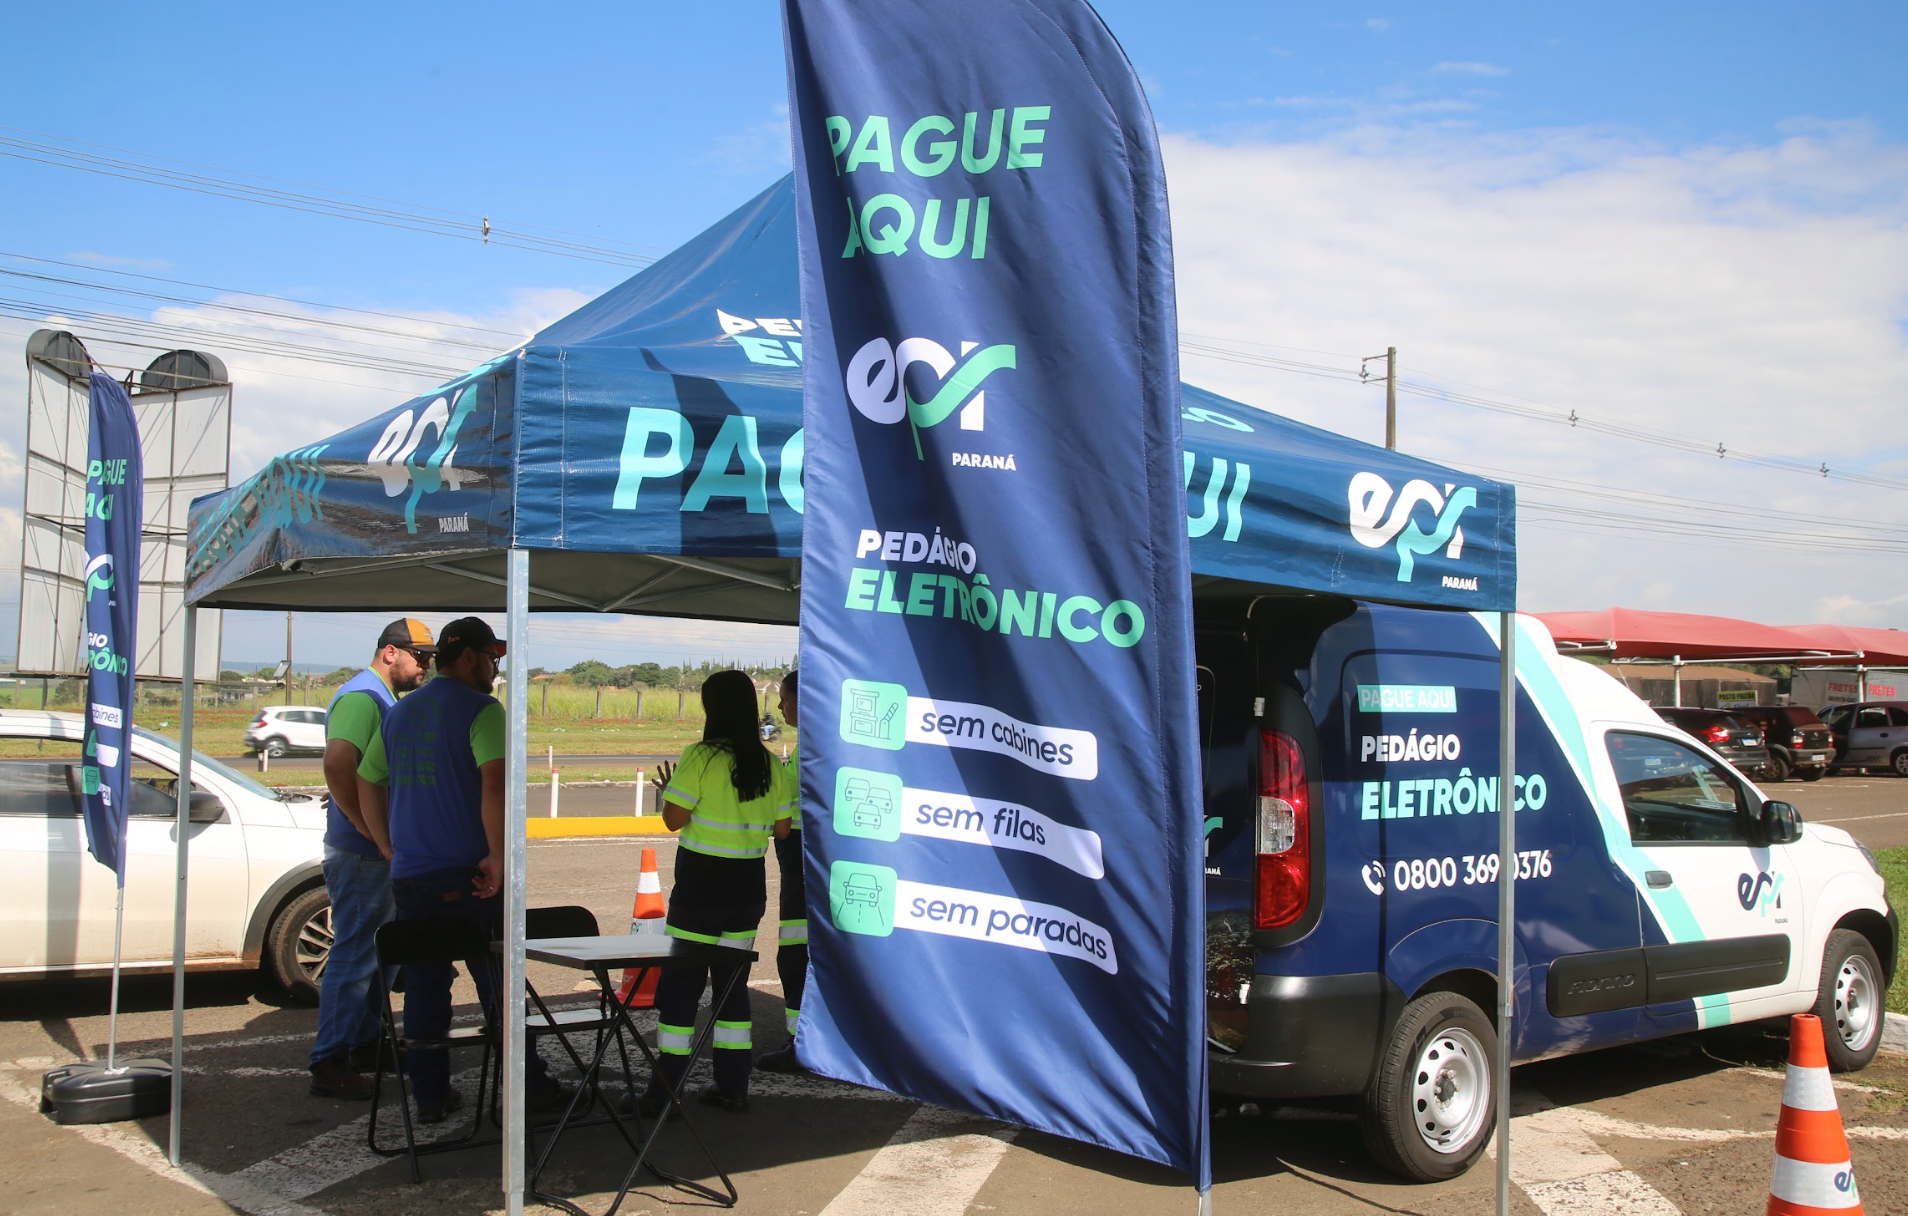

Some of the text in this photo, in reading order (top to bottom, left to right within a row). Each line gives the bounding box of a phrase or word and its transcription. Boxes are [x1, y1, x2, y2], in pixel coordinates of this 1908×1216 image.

[825, 105, 1052, 177] PAGUE
[952, 452, 1017, 471] PARANÁ
[439, 512, 470, 532] PARANÁ
[856, 526, 977, 574] PEDÁGIO
[1441, 575, 1478, 591] PARANÁ
[845, 566, 1146, 648] ELETRÔNICO
[1361, 688, 1455, 708] PAGUE AQUI
[1828, 682, 1897, 698] FRETES FRETES
[920, 712, 1074, 766] sem cabines
[1361, 728, 1461, 762] PEDÁGIO
[1361, 767, 1547, 821] ELETRÔNCO
[916, 804, 1046, 846] sem filas
[1394, 857, 1457, 891] 0800
[1462, 853, 1500, 885] 369
[910, 897, 1108, 960] sem paradas
